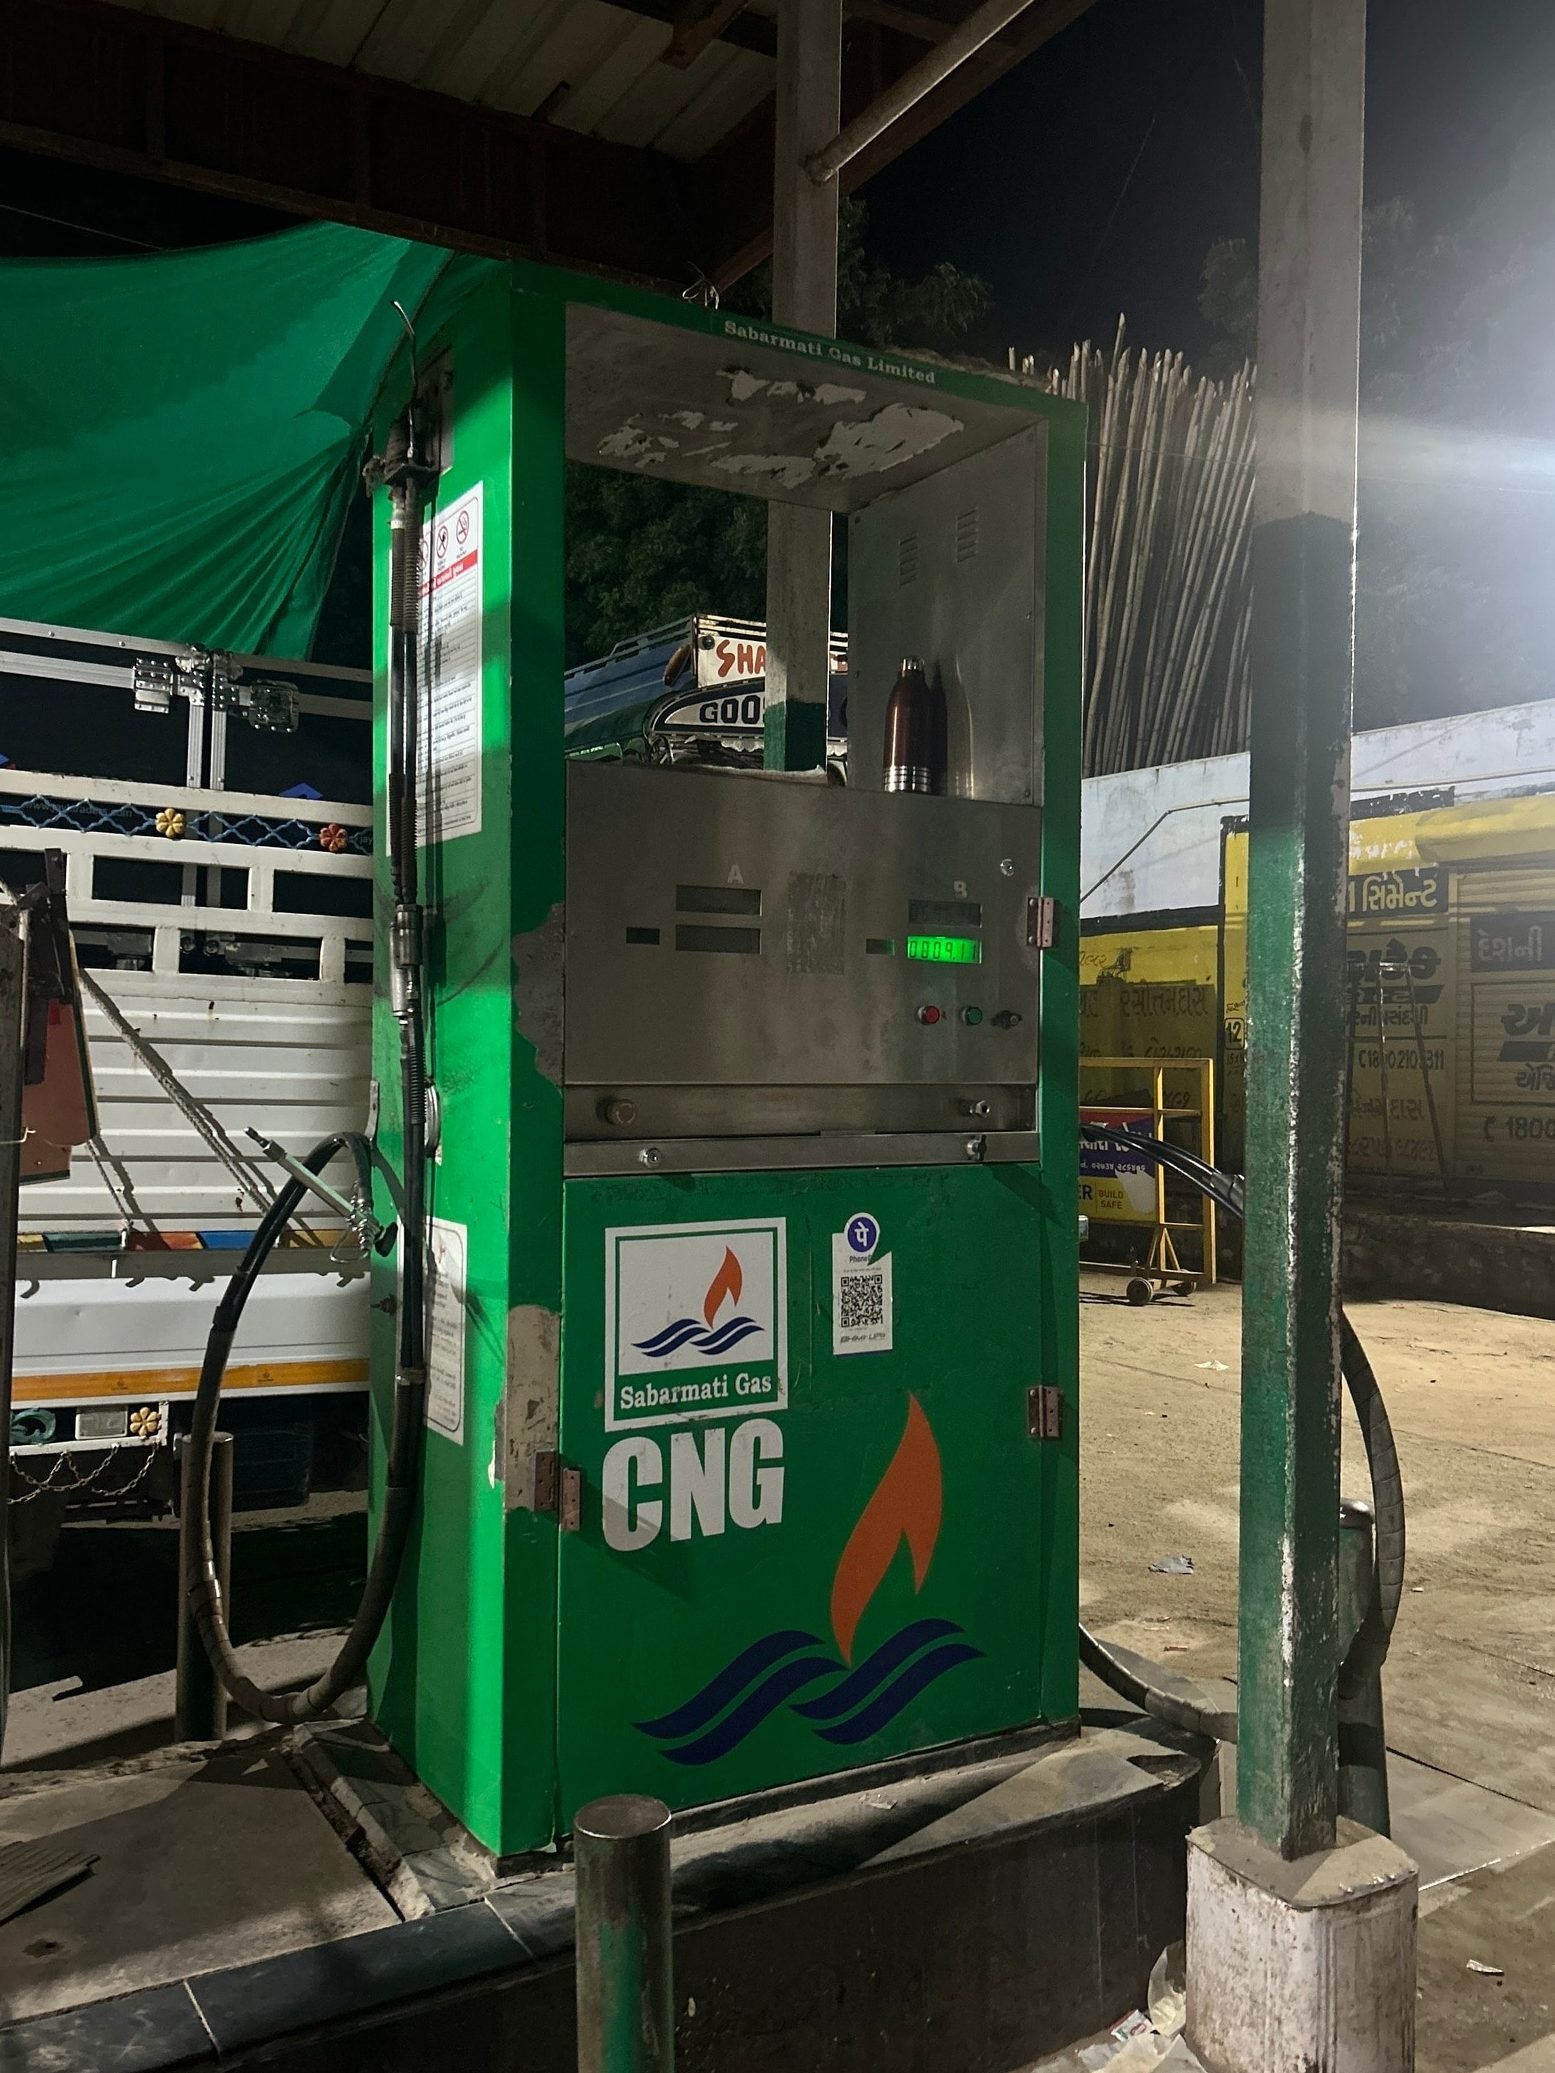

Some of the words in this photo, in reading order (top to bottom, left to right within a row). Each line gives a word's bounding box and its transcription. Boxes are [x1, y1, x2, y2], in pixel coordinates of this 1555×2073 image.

[724, 319, 823, 357] Sabarmati
[828, 347, 862, 367] Gas
[867, 356, 936, 384] Limited
[699, 694, 765, 724] GOO
[727, 863, 744, 884] A
[1226, 1020, 1242, 1042] 12
[1098, 1189, 1124, 1200] BUILD
[1100, 1200, 1123, 1210] SAFE
[854, 1220, 869, 1247] पे
[619, 1374, 729, 1410] Sabarmati
[735, 1371, 772, 1397] Gas
[602, 1418, 785, 1552] CNG
